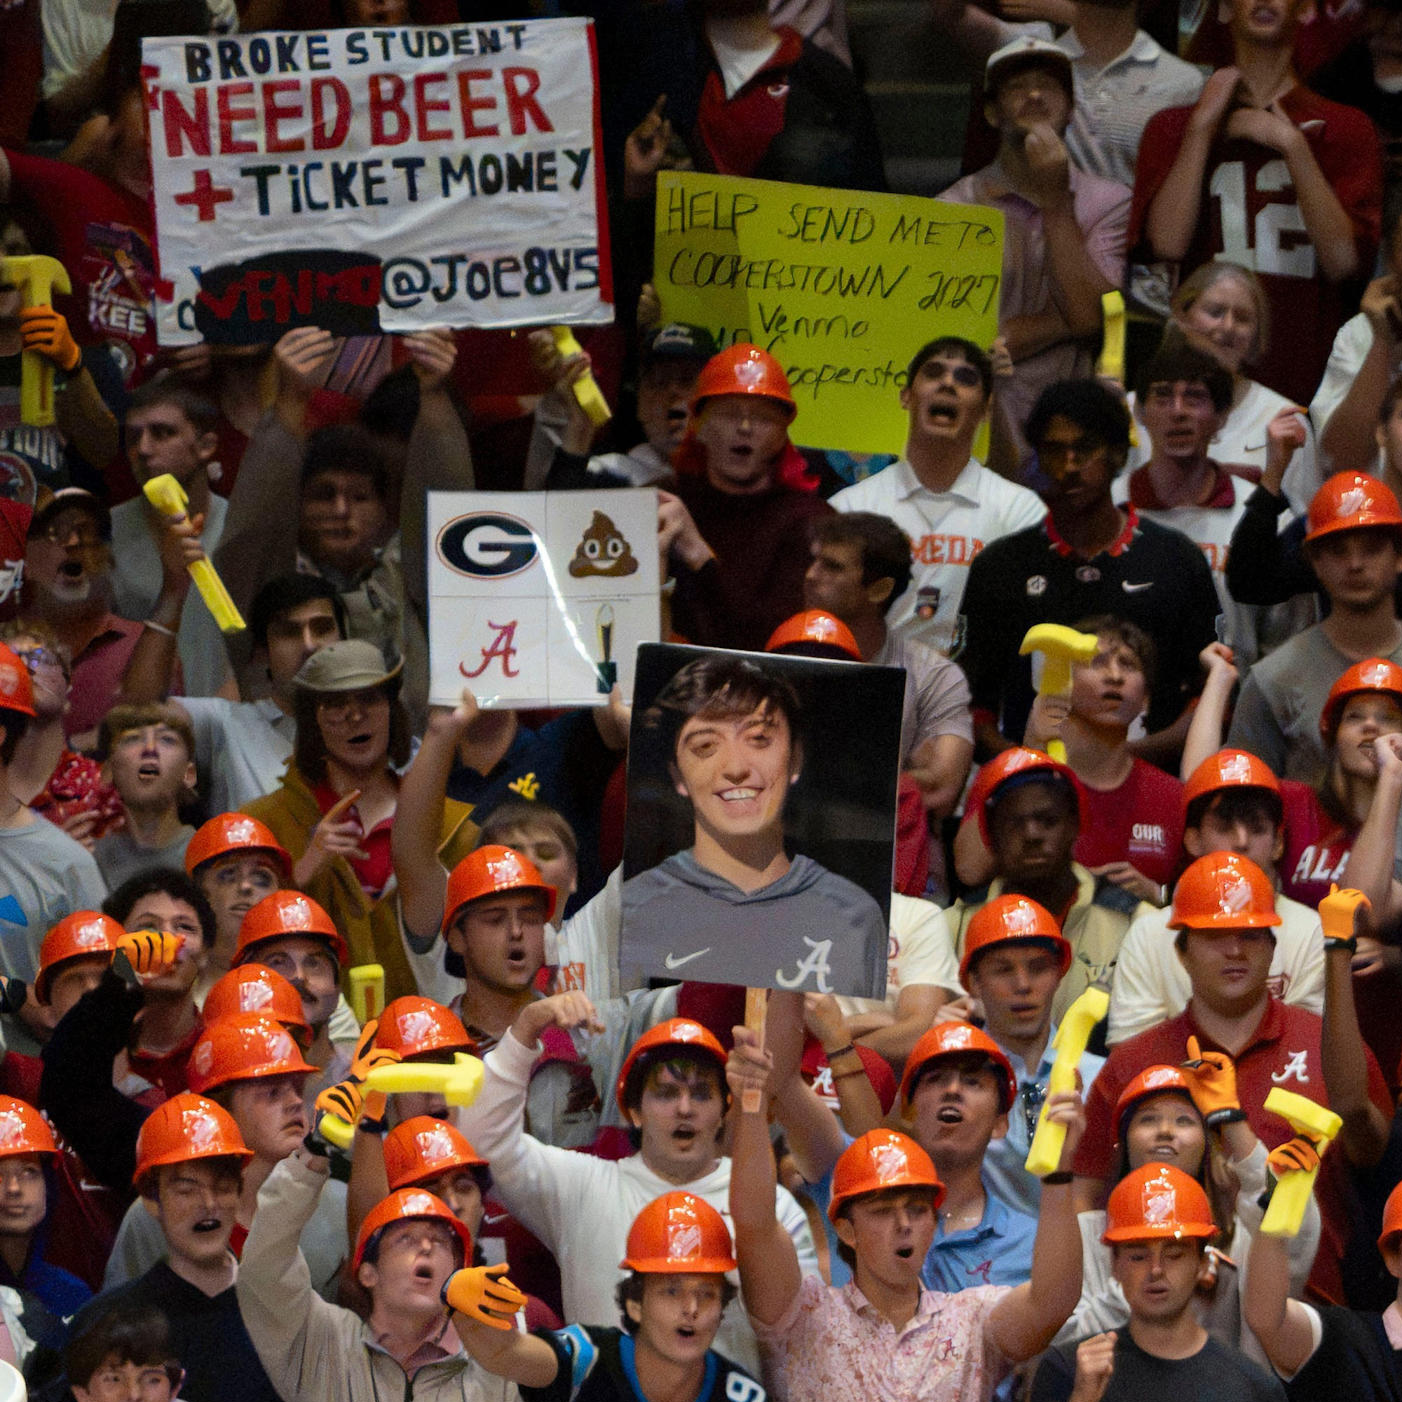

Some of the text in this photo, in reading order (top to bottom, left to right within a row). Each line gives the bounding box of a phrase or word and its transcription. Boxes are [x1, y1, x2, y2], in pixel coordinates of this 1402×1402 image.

[184, 25, 526, 83] BROKE STUDENT
[162, 67, 555, 158] NEED BEER
[439, 147, 592, 198] MONEY
[667, 187, 758, 235] HELP
[778, 202, 875, 246] SEND
[1209, 159, 1316, 280] 12
[669, 248, 999, 314] COOPERSTOWN 2027
[758, 303, 870, 339] Venmo
[438, 513, 539, 579] G
[459, 620, 519, 678] A
[1132, 823, 1164, 842] OUR
